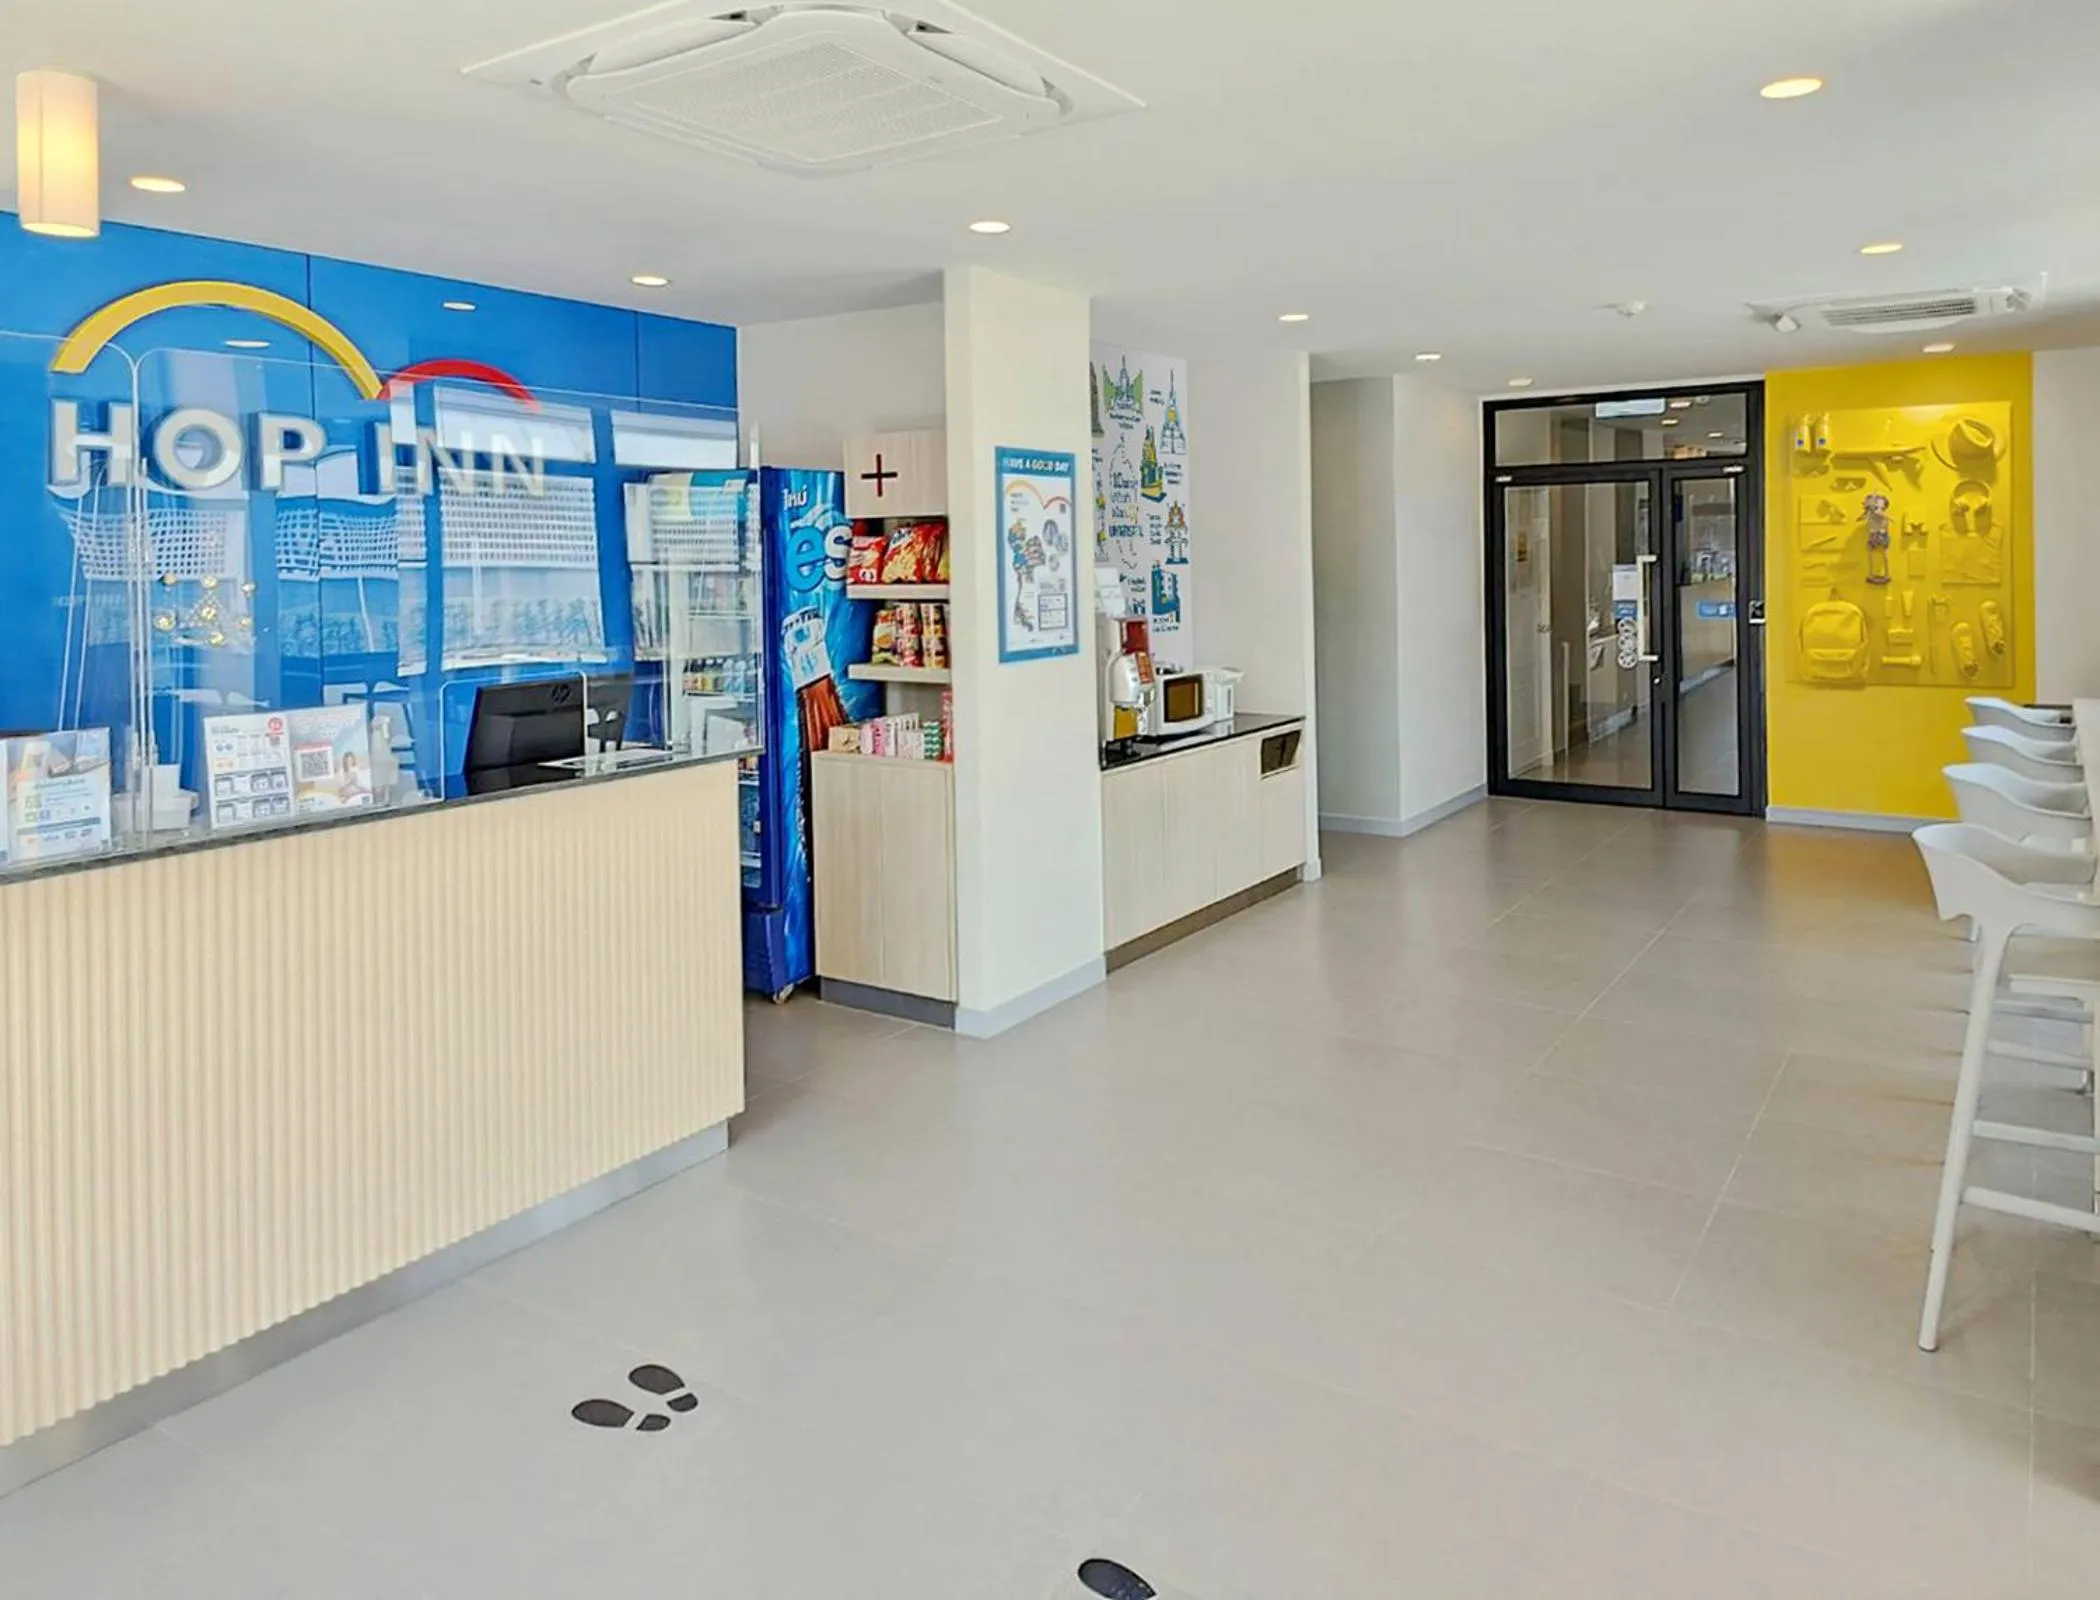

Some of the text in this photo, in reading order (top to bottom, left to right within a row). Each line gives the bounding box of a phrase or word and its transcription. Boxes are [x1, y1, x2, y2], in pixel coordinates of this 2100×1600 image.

[48, 401, 544, 497] HOP INN
[1054, 460, 1070, 472] DAY
